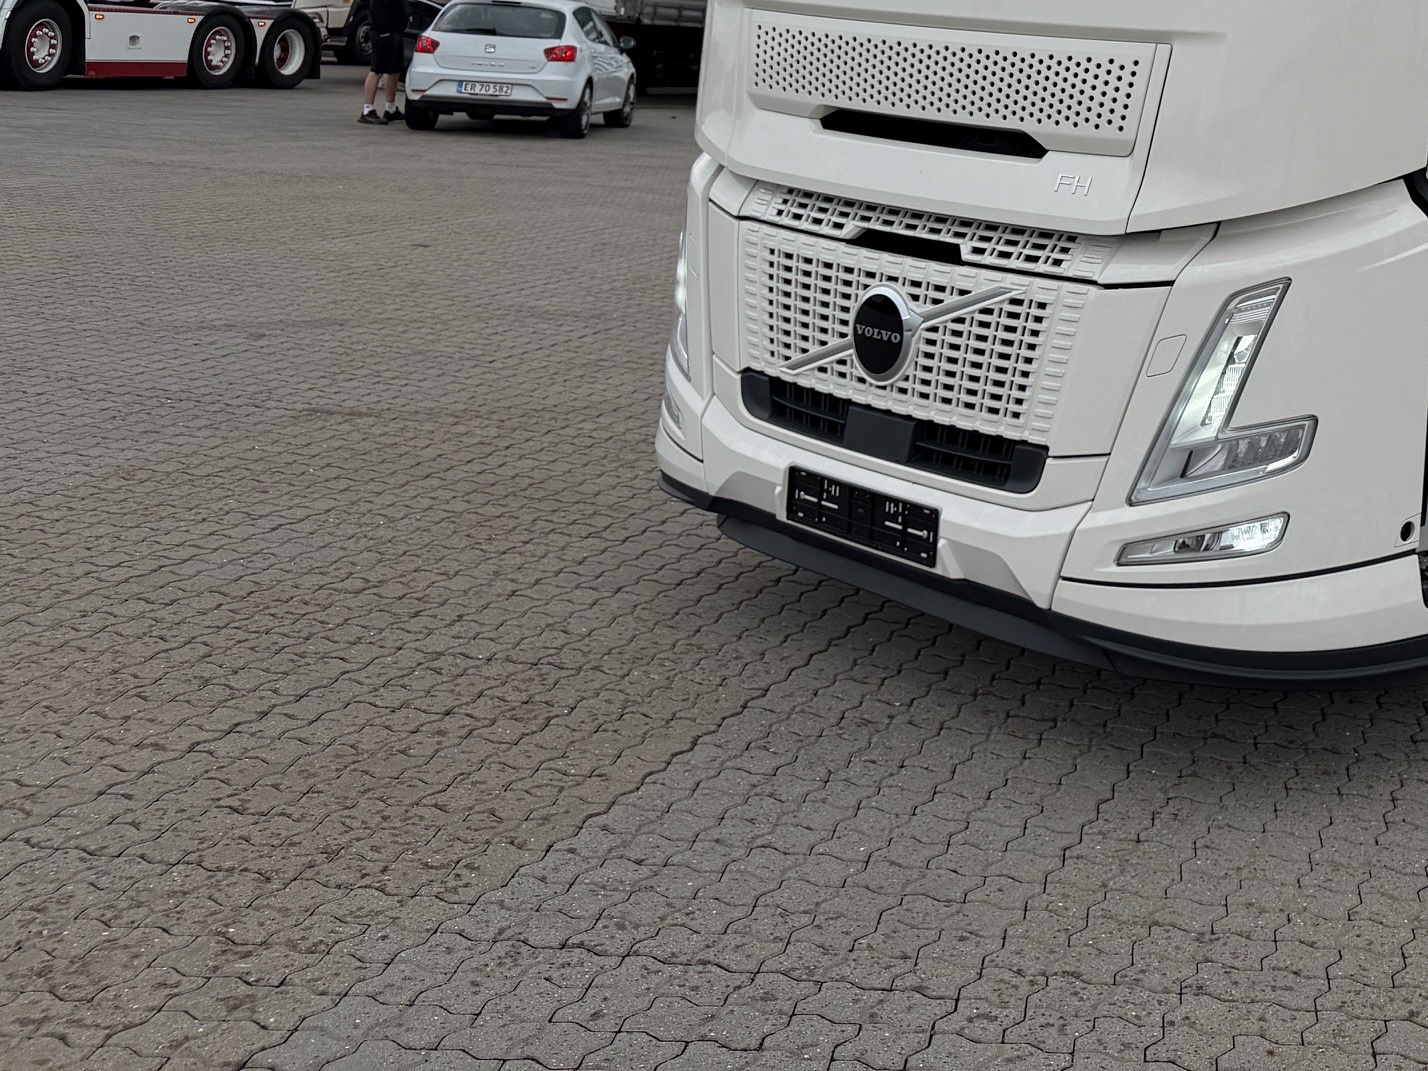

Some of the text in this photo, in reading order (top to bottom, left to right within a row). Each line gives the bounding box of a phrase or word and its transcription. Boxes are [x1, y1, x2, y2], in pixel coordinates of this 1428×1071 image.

[464, 83, 510, 95] ER 70 582
[1054, 173, 1093, 196] FH
[855, 323, 900, 344] VOLVO
